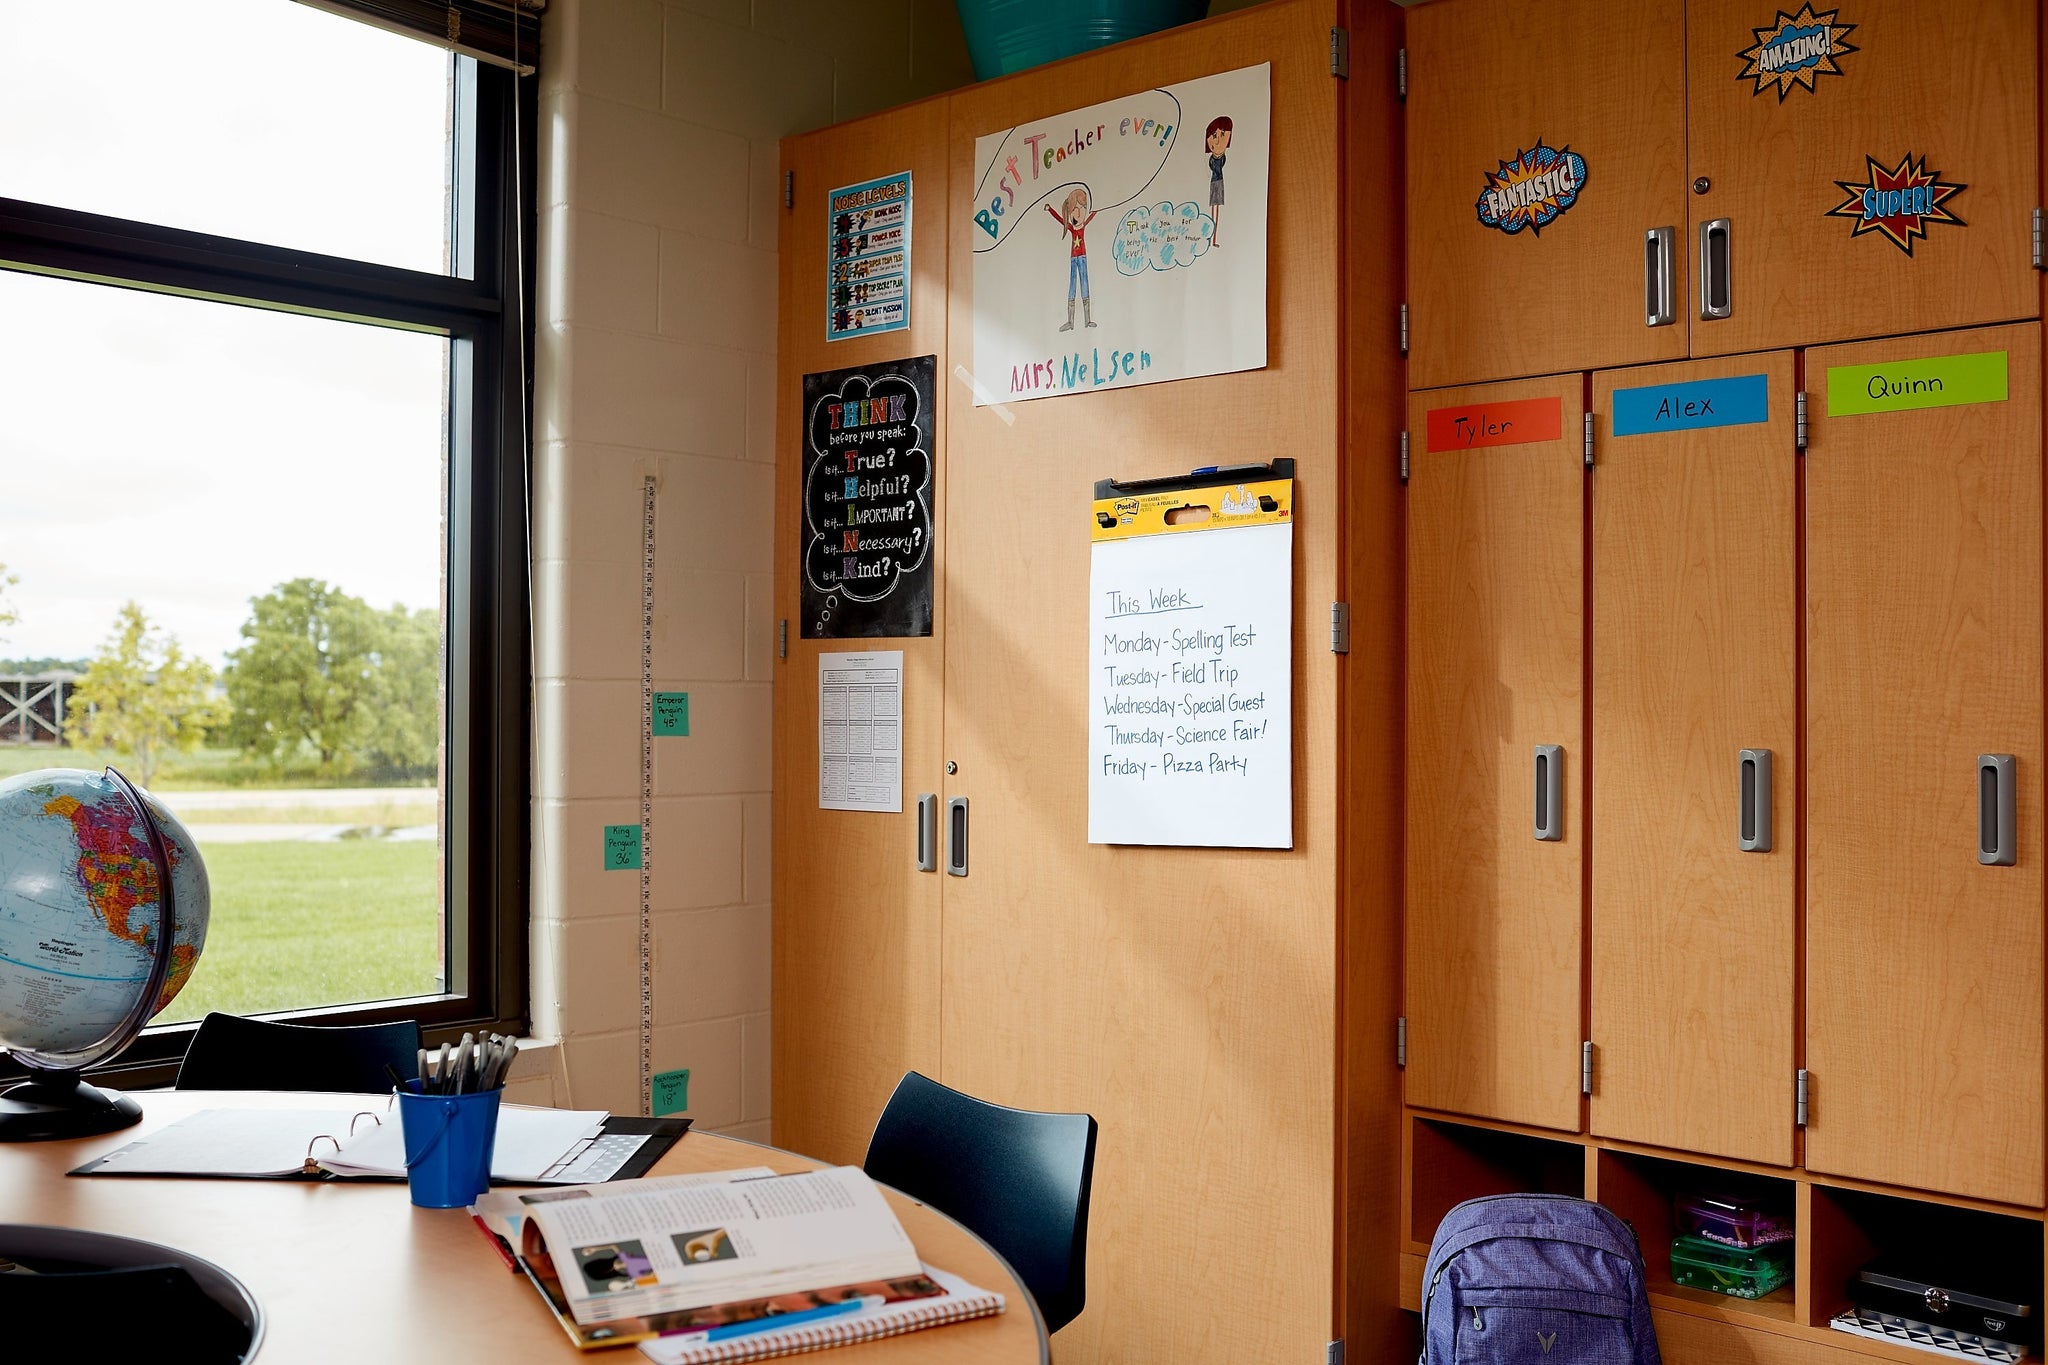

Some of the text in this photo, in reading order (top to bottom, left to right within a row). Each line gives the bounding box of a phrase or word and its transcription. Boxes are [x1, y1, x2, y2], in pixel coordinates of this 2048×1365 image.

[1758, 25, 1832, 73] AMAZING!
[973, 117, 1173, 239] Best Teacher ever!
[1487, 155, 1575, 220] FANTASTIC!
[1862, 184, 1934, 220] SUPER!
[1159, 220, 1171, 228] you
[840, 238, 849, 256] 3
[839, 263, 848, 282] 2
[1010, 358, 1056, 393] Mrs.
[1866, 373, 1944, 400] Quinn
[828, 394, 907, 430] THINK
[1654, 396, 1715, 422] Alex
[829, 424, 906, 445] before you speak:
[1453, 416, 1513, 448] Tyler
[845, 447, 896, 472] True?
[844, 474, 910, 501] Helpful?
[847, 500, 915, 526] IMPORTANT?
[1117, 502, 1137, 511] Post-it
[1278, 509, 1289, 517] 3M
[843, 527, 922, 554] Necessary?
[843, 557, 891, 579] Kind?
[1106, 587, 1192, 614] This Week
[1171, 628, 1224, 657] Spelling
[1223, 624, 1257, 647] Test
[1172, 661, 1205, 683] Field
[1209, 658, 1239, 688] Trip
[657, 694, 685, 706] Emperor
[658, 706, 683, 718] Penguin
[1228, 691, 1266, 713] Guest
[1176, 725, 1227, 746] Science
[1233, 718, 1268, 741] Fair!
[1103, 754, 1147, 781] Friday
[1163, 752, 1203, 776] Pizza
[1208, 752, 1248, 777] Party
[608, 838, 637, 852] Penguin
[613, 826, 630, 838] King
